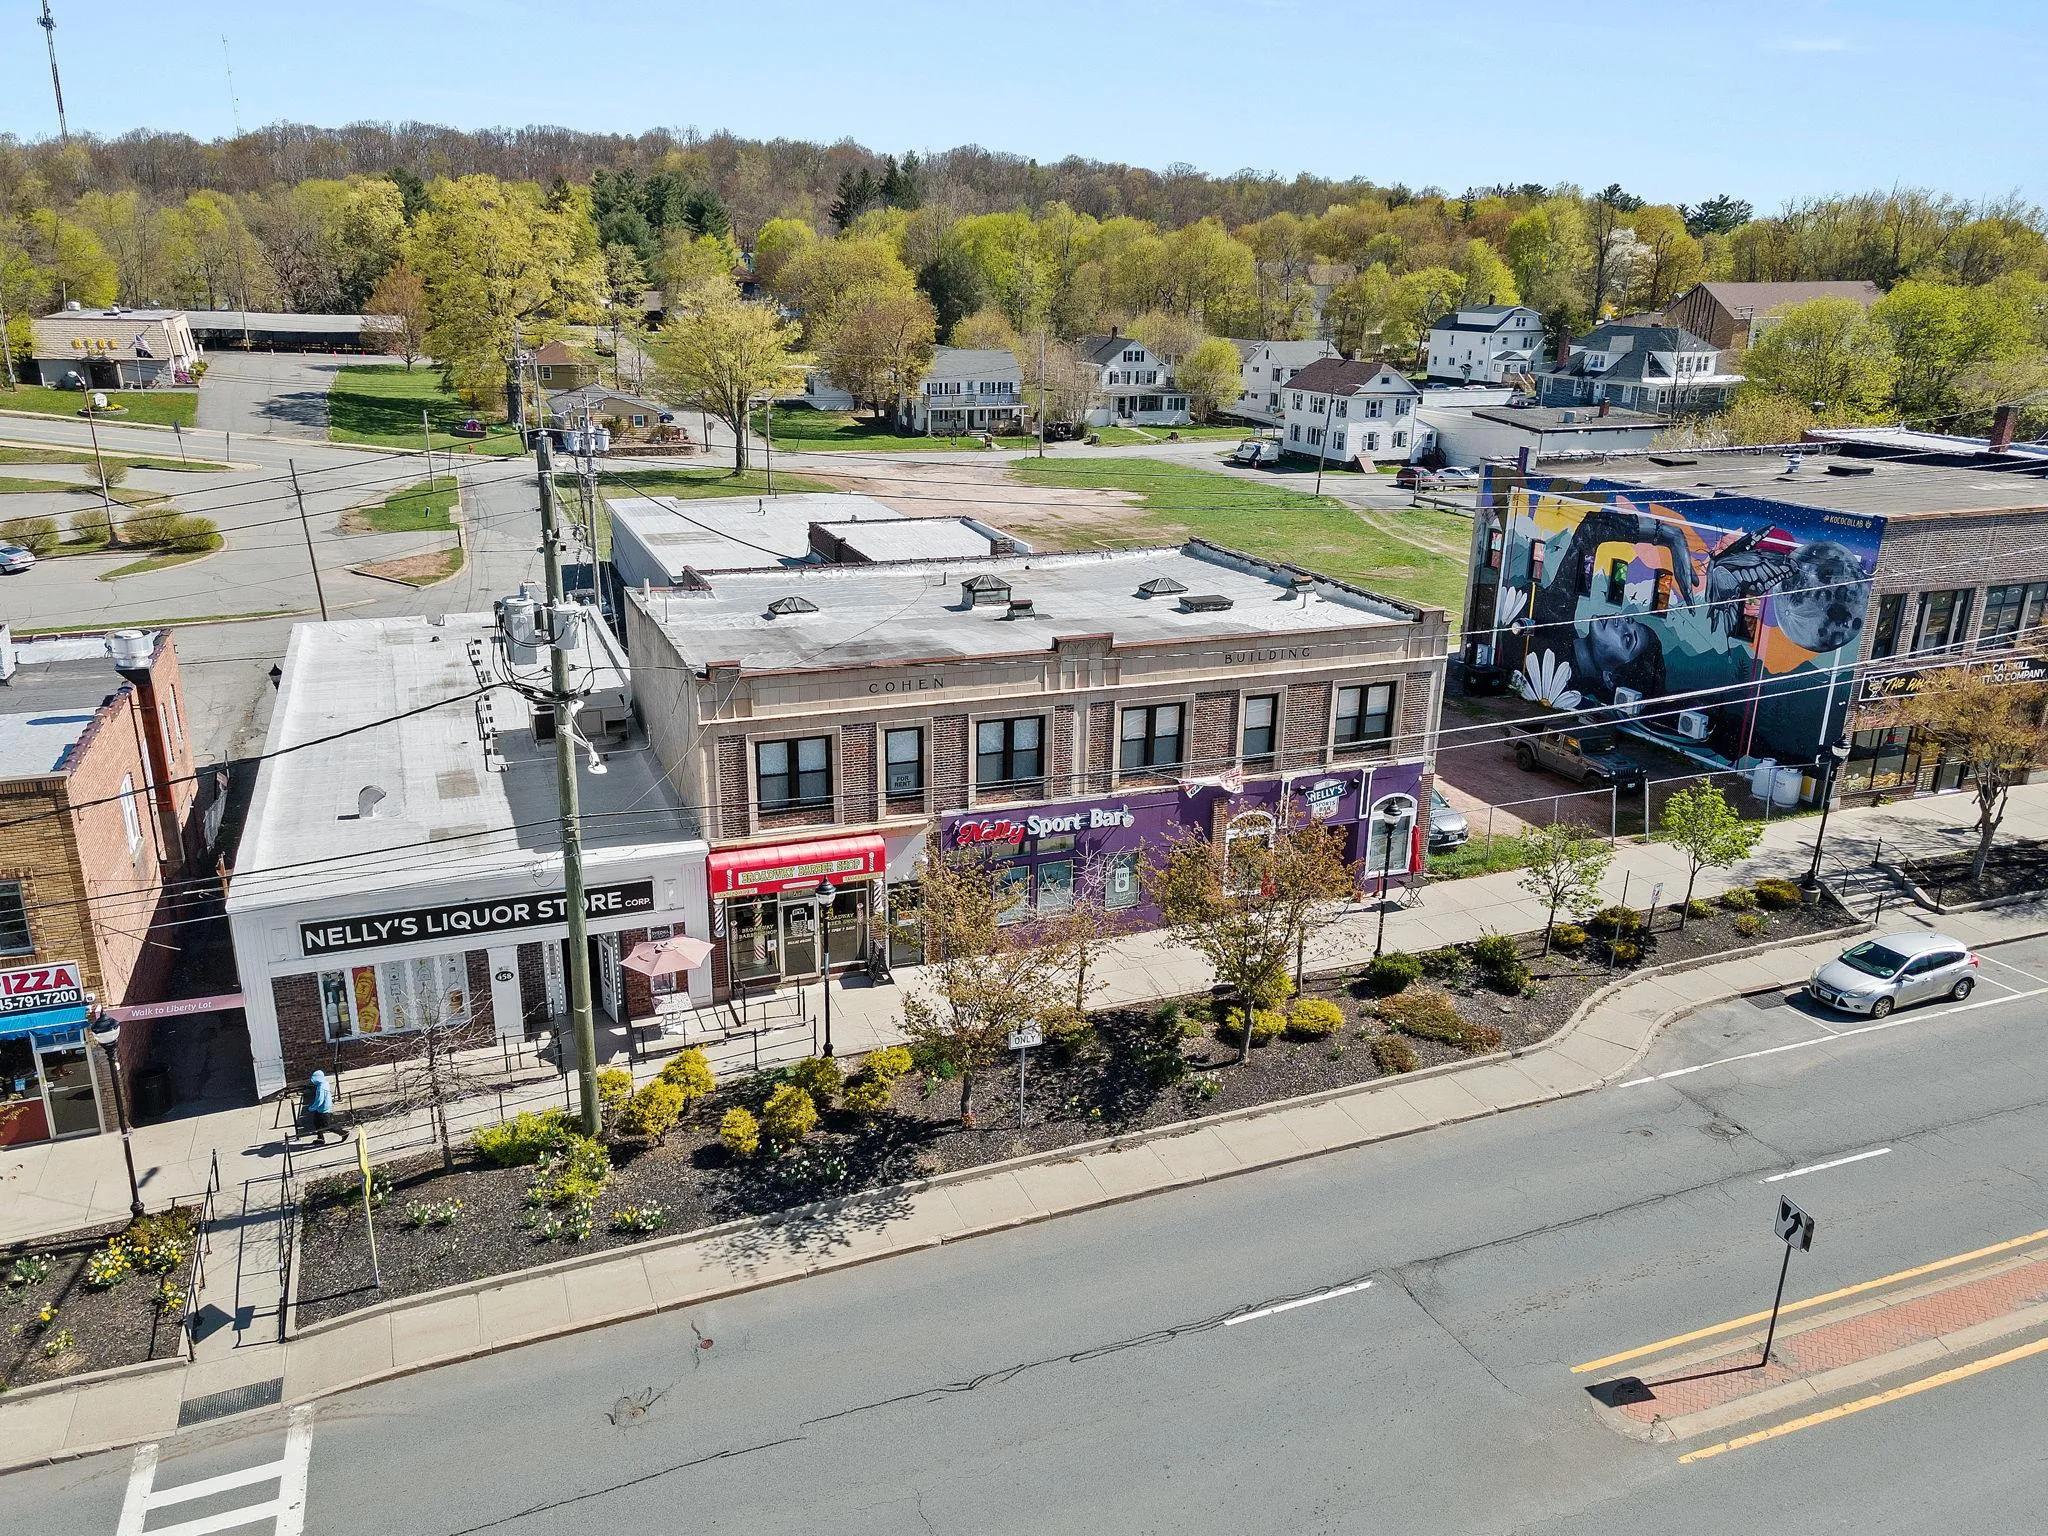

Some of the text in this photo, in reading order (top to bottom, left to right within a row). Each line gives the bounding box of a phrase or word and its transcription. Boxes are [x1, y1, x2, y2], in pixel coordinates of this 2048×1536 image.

[868, 647, 1310, 693] COHEN BUILDING
[2004, 668, 2046, 681] COMPANY
[1310, 784, 1344, 802] NELLY'S
[1315, 800, 1336, 808] SPORTS
[957, 807, 1125, 845] Nelly Sport Bar
[741, 858, 861, 883] BROADWAY BARBER SHOP
[305, 916, 418, 949] NELLY'S
[426, 902, 530, 934] LIQUOR
[625, 897, 651, 908] CORP.
[0, 968, 76, 995] IZZA
[131, 1009, 152, 1017] Walk
[166, 1004, 196, 1015] Liberty
[198, 1001, 212, 1010] Lot
[1014, 1035, 1036, 1045] ONLY
